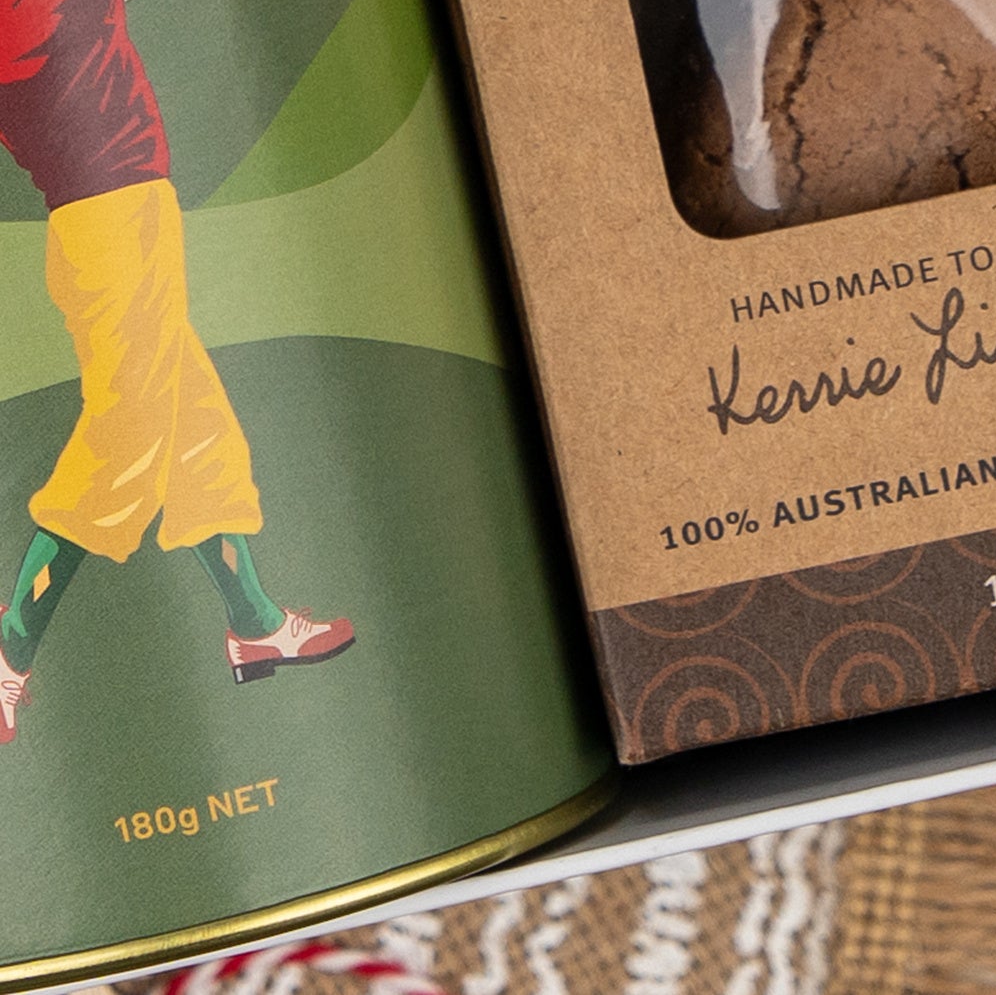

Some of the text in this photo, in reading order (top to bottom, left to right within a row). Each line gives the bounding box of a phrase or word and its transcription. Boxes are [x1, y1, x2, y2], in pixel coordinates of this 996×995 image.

[730, 257, 939, 323] HANDMADE
[948, 246, 993, 275] TO
[707, 336, 902, 435] Kerrie
[660, 509, 759, 550] 100%
[114, 778, 279, 843] 180g NET
